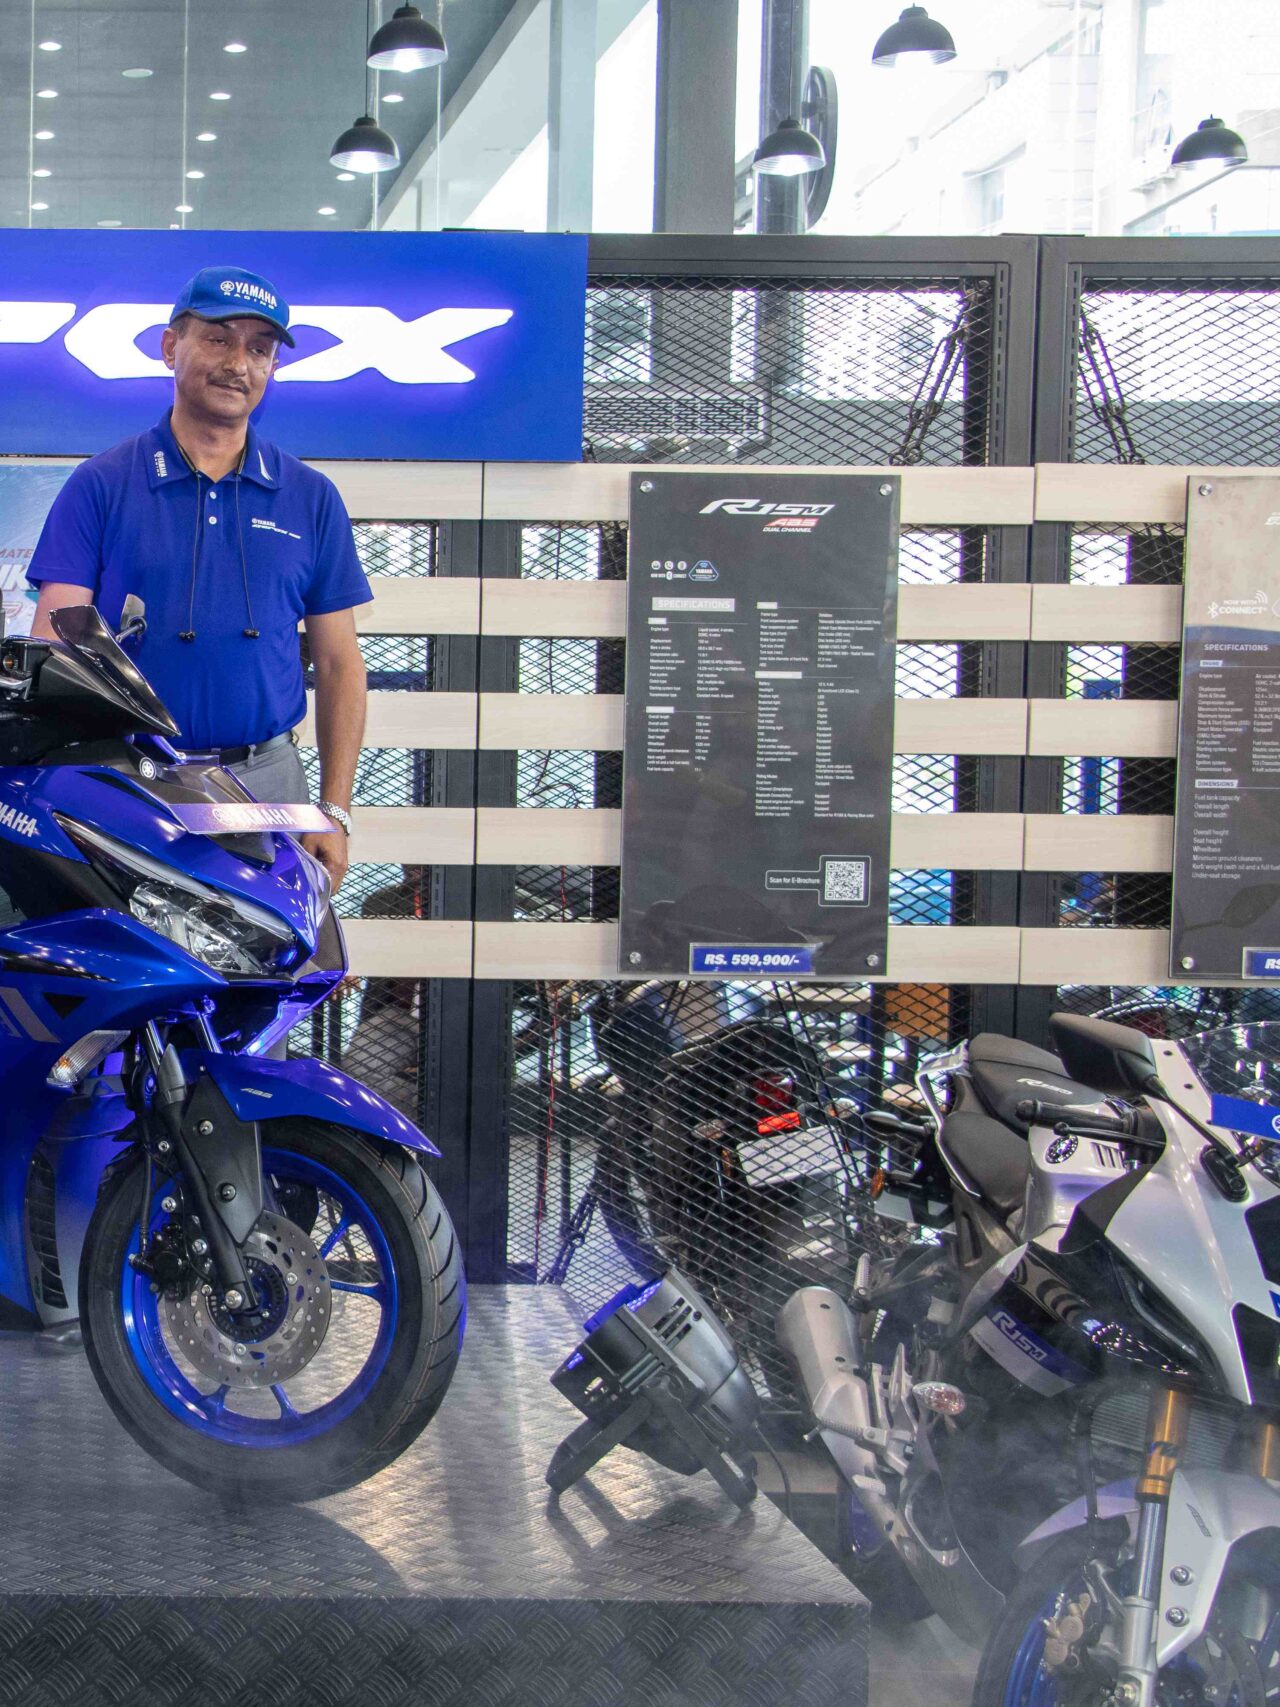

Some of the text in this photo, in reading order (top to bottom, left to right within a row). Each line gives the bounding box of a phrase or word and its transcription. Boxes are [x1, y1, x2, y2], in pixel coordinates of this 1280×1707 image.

[235, 281, 277, 307] YAMAHA
[766, 518, 819, 527] ABS
[657, 599, 731, 610] SPECIFICATIONS
[1219, 606, 1262, 614] CONNECT
[1204, 643, 1269, 651] SPECIFICATIONS
[791, 877, 820, 885] E-Brochure
[704, 953, 799, 968] RS. 599,900/-
[992, 1310, 1048, 1362] R15M
